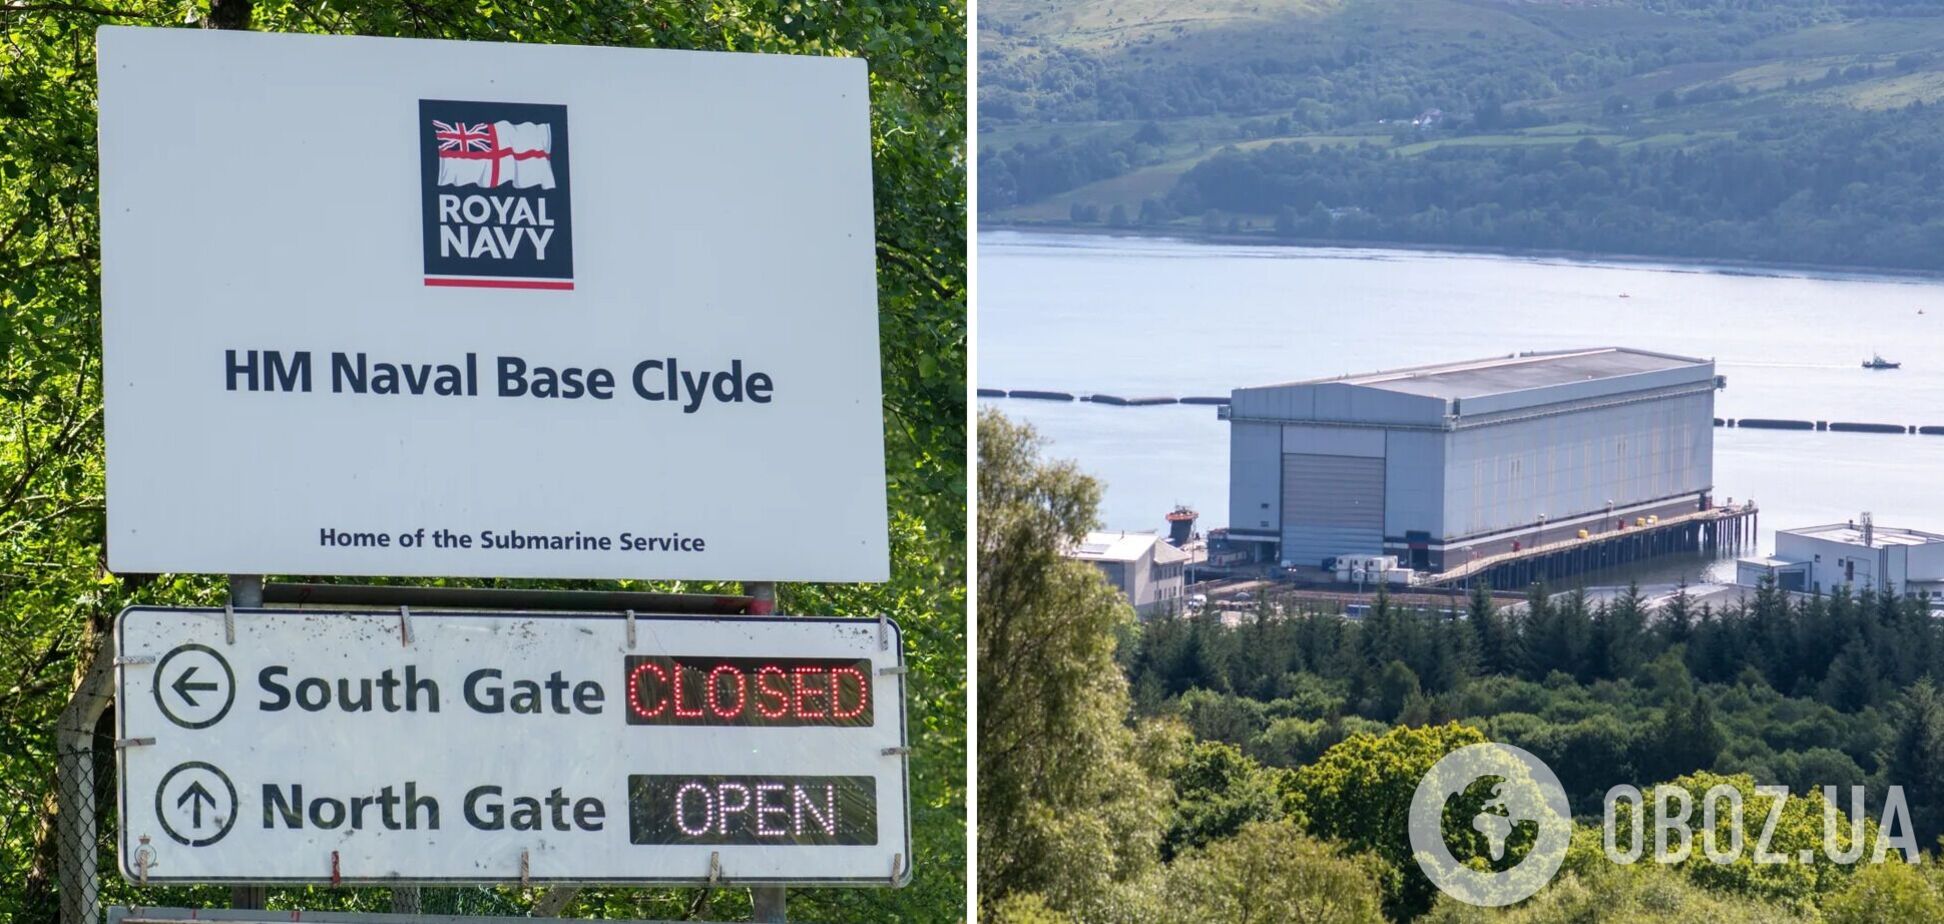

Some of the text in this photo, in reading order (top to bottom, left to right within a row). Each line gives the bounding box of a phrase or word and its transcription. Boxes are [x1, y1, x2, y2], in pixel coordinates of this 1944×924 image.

[440, 195, 554, 226] ROYAL
[441, 224, 554, 260] NAVY
[225, 350, 774, 414] HM Naval Base Clyde
[320, 528, 706, 552] Home of the Submarine Service
[257, 664, 606, 715] South Gate
[629, 662, 868, 719] CLOSED
[261, 781, 606, 832] North Gate
[675, 783, 835, 836] OPEN
